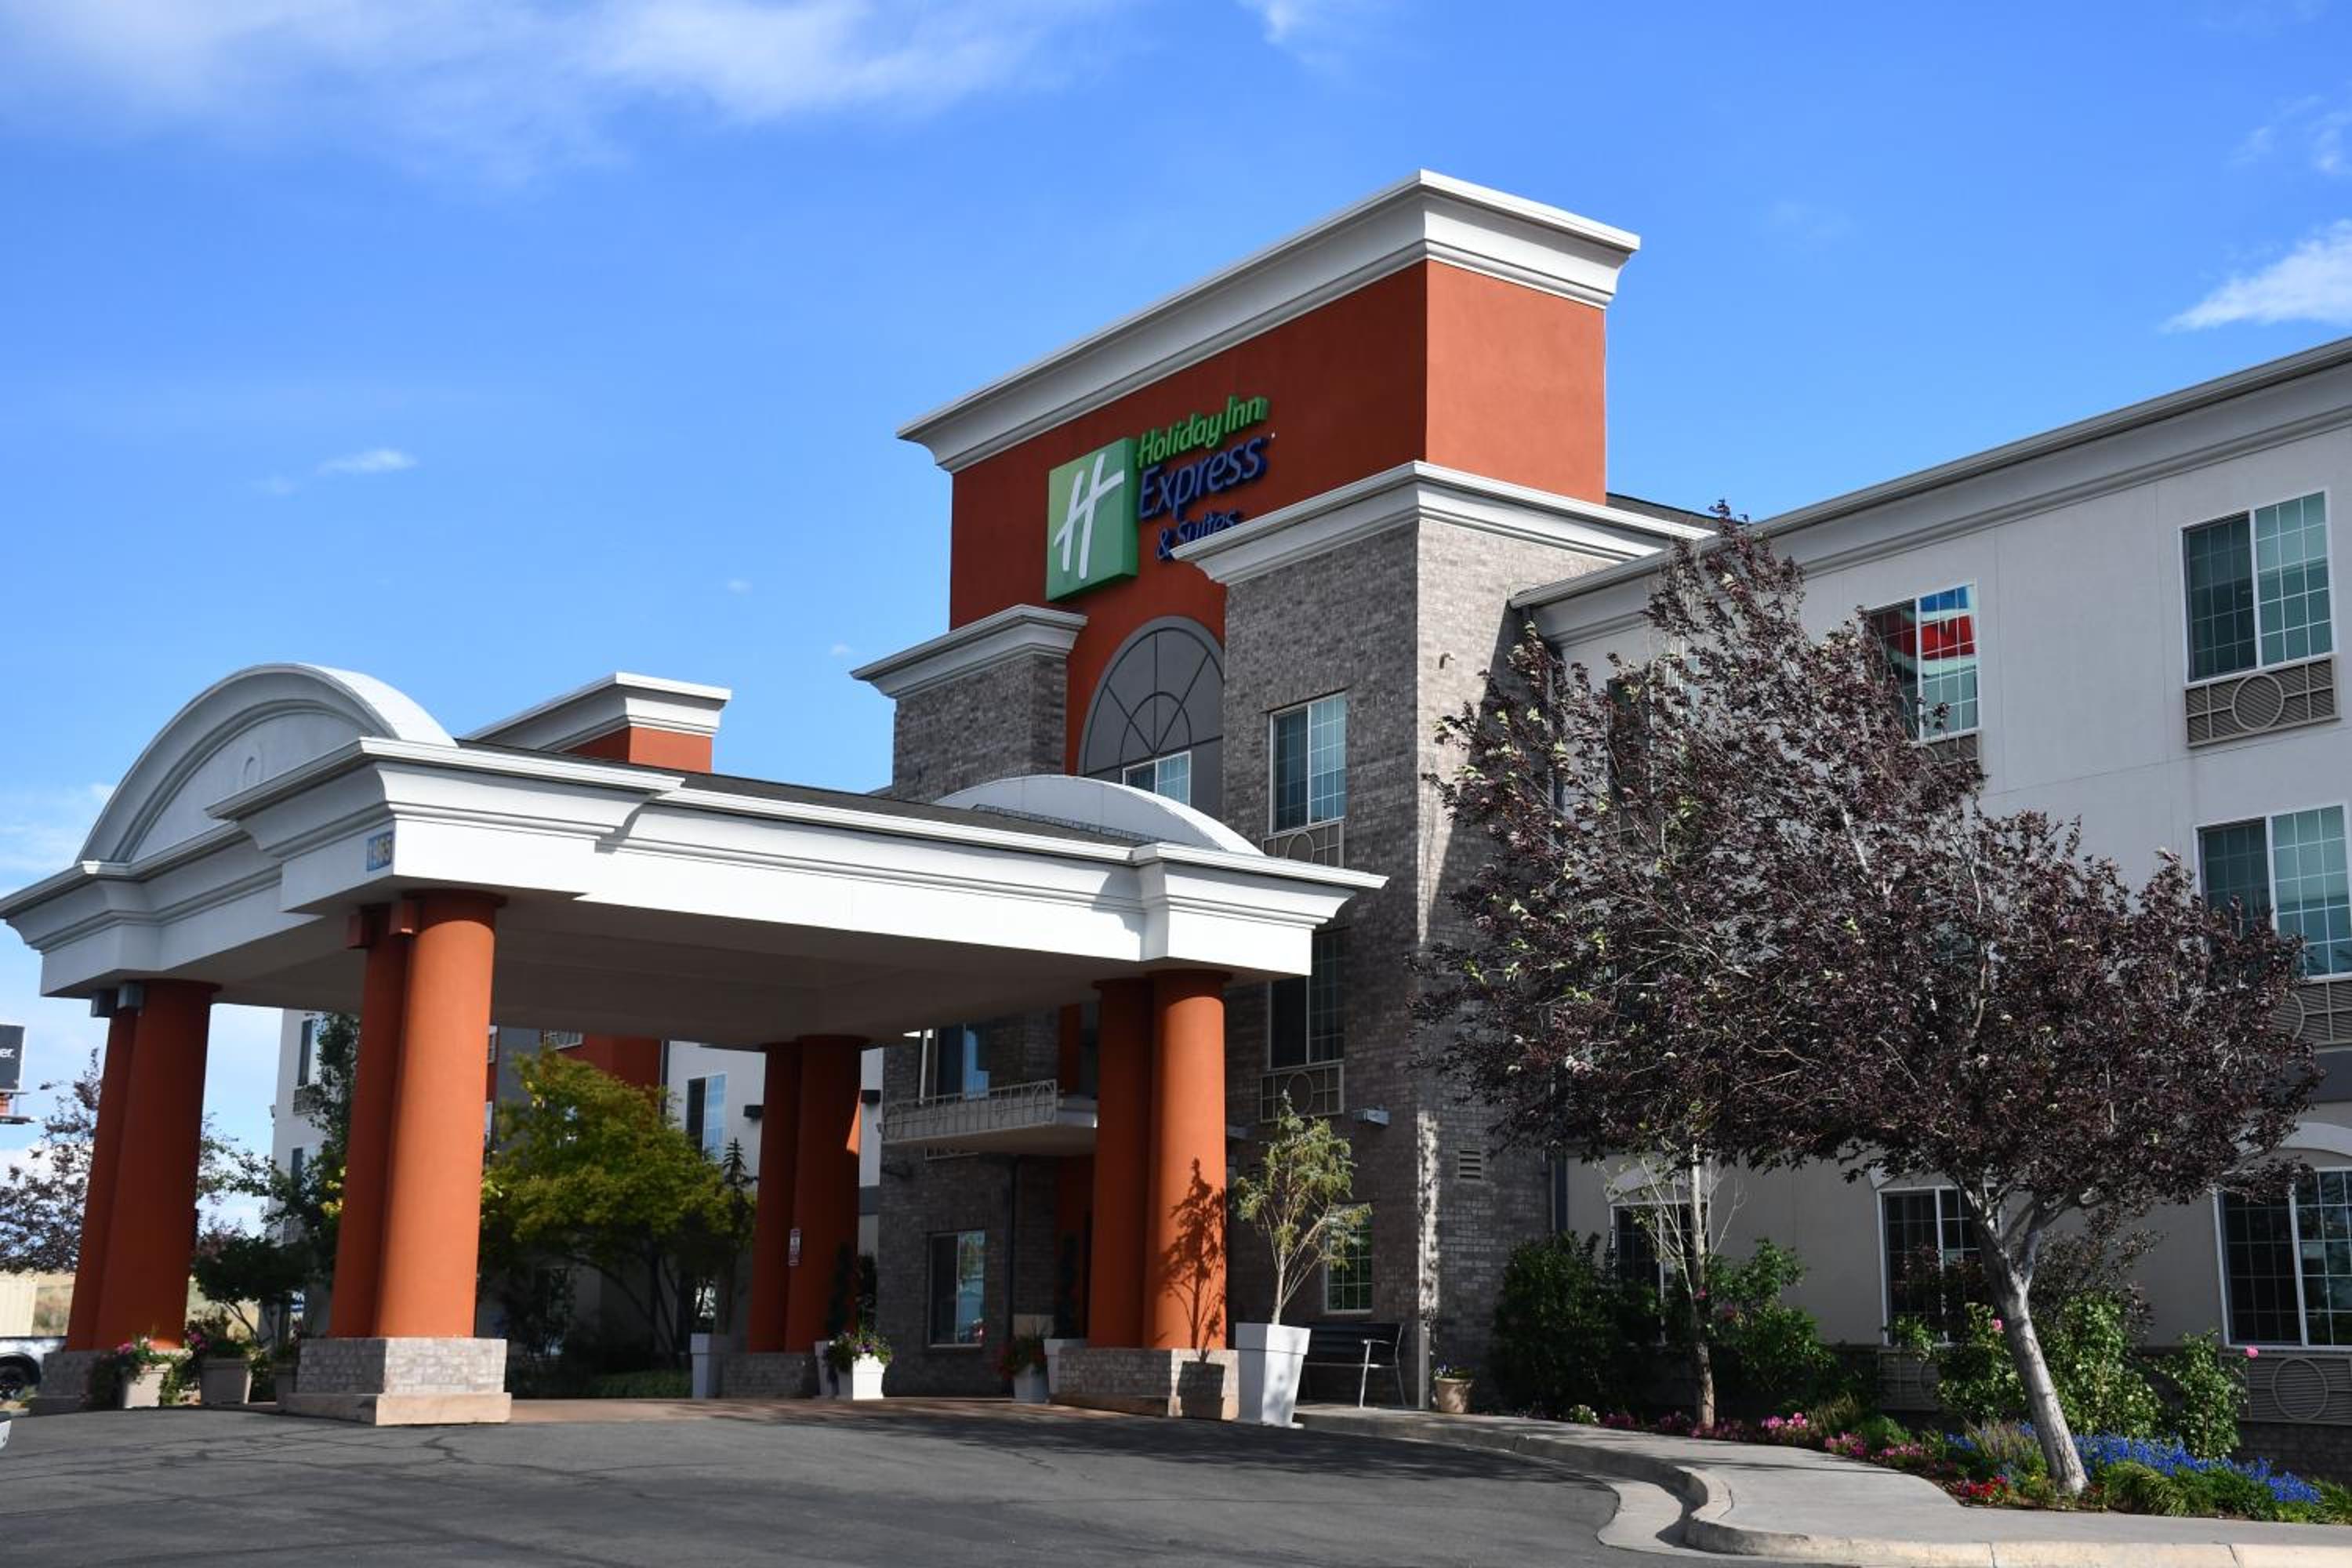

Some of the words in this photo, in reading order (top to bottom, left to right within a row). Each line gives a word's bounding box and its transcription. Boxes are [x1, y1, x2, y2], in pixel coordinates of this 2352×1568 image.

[1138, 412, 1222, 469] Holiday
[1225, 394, 1269, 433] Inn
[1139, 437, 1267, 520] Express
